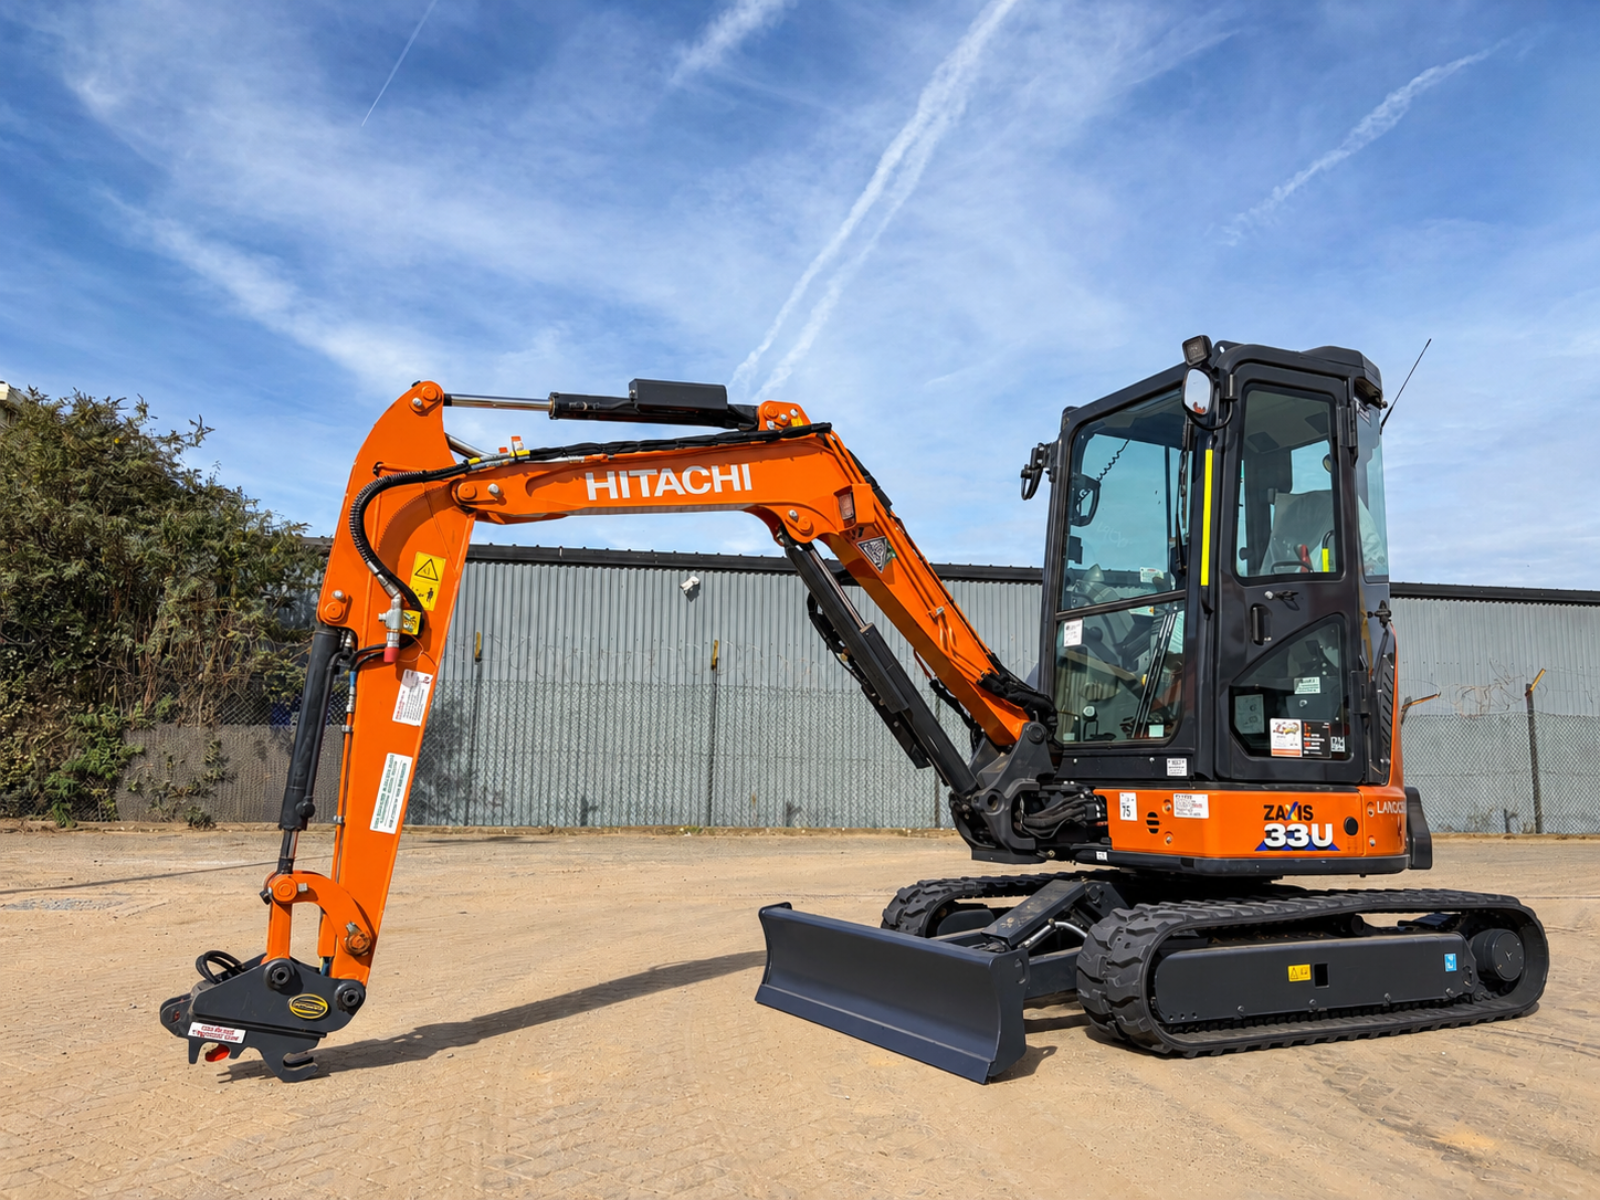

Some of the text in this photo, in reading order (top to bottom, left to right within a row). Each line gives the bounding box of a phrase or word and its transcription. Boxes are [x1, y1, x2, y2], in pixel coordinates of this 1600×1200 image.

[585, 463, 752, 501] HITACHI
[1263, 802, 1314, 821] ZAXIS
[1263, 823, 1334, 848] 33U
